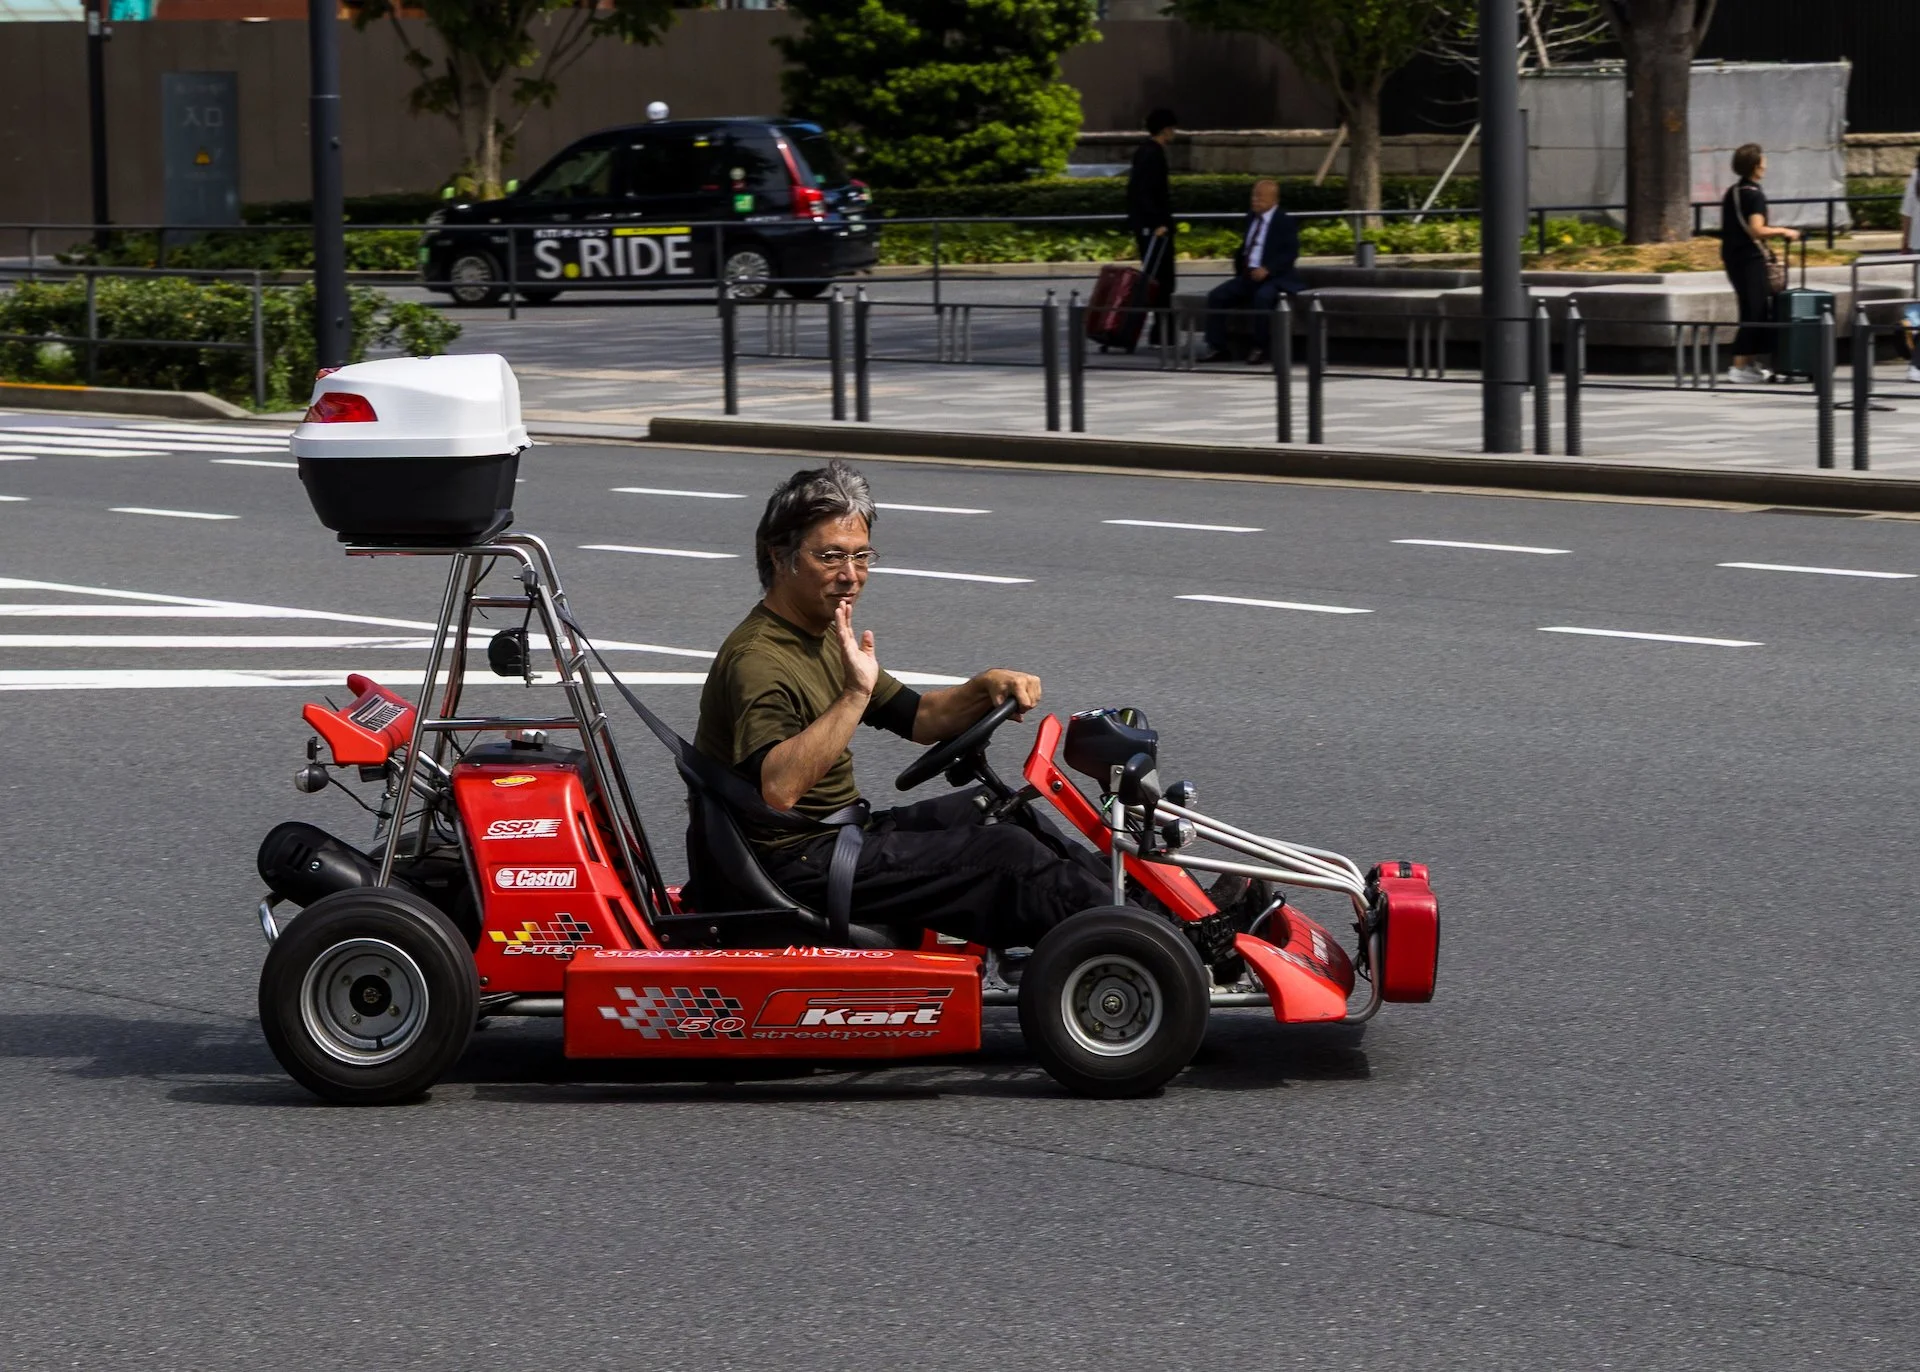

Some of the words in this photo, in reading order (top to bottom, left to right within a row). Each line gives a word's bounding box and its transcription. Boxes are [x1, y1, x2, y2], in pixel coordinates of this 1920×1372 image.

[182, 106, 223, 127] 入口
[534, 236, 694, 279] S.RIDE
[516, 870, 574, 887] Castrol
[677, 1016, 746, 1033] 50
[801, 1008, 942, 1026] Kart
[752, 1028, 941, 1041] streetpower
